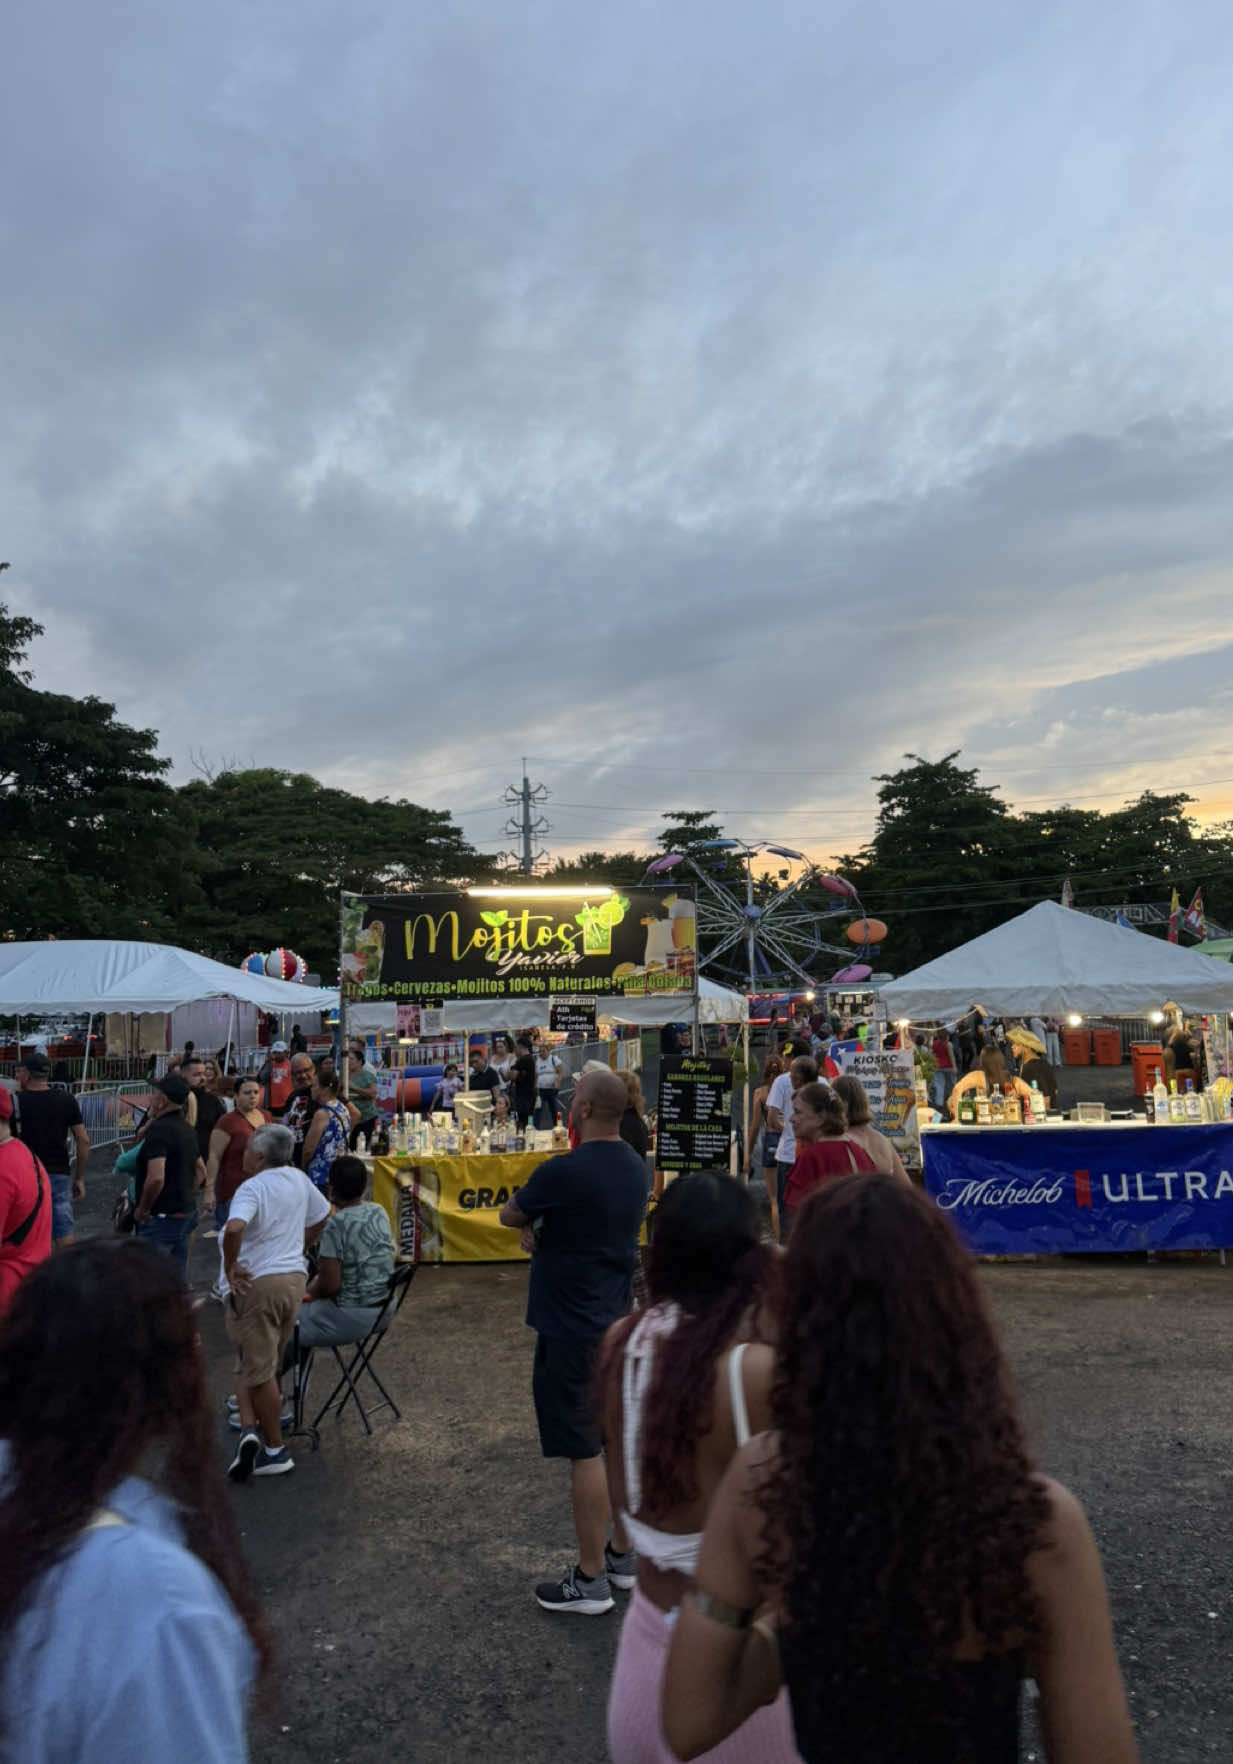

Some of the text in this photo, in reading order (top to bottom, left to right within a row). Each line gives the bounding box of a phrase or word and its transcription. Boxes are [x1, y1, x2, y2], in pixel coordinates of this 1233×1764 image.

[404, 908, 584, 962] Mojitos
[346, 982, 388, 997] Tragos
[394, 980, 451, 995] Cervezas
[456, 978, 505, 994] Mojitos
[508, 976, 546, 992] 100%
[549, 974, 612, 991] Naturales
[458, 1186, 524, 1210] GRA
[936, 1170, 1233, 1209] Michelob ULTRA
